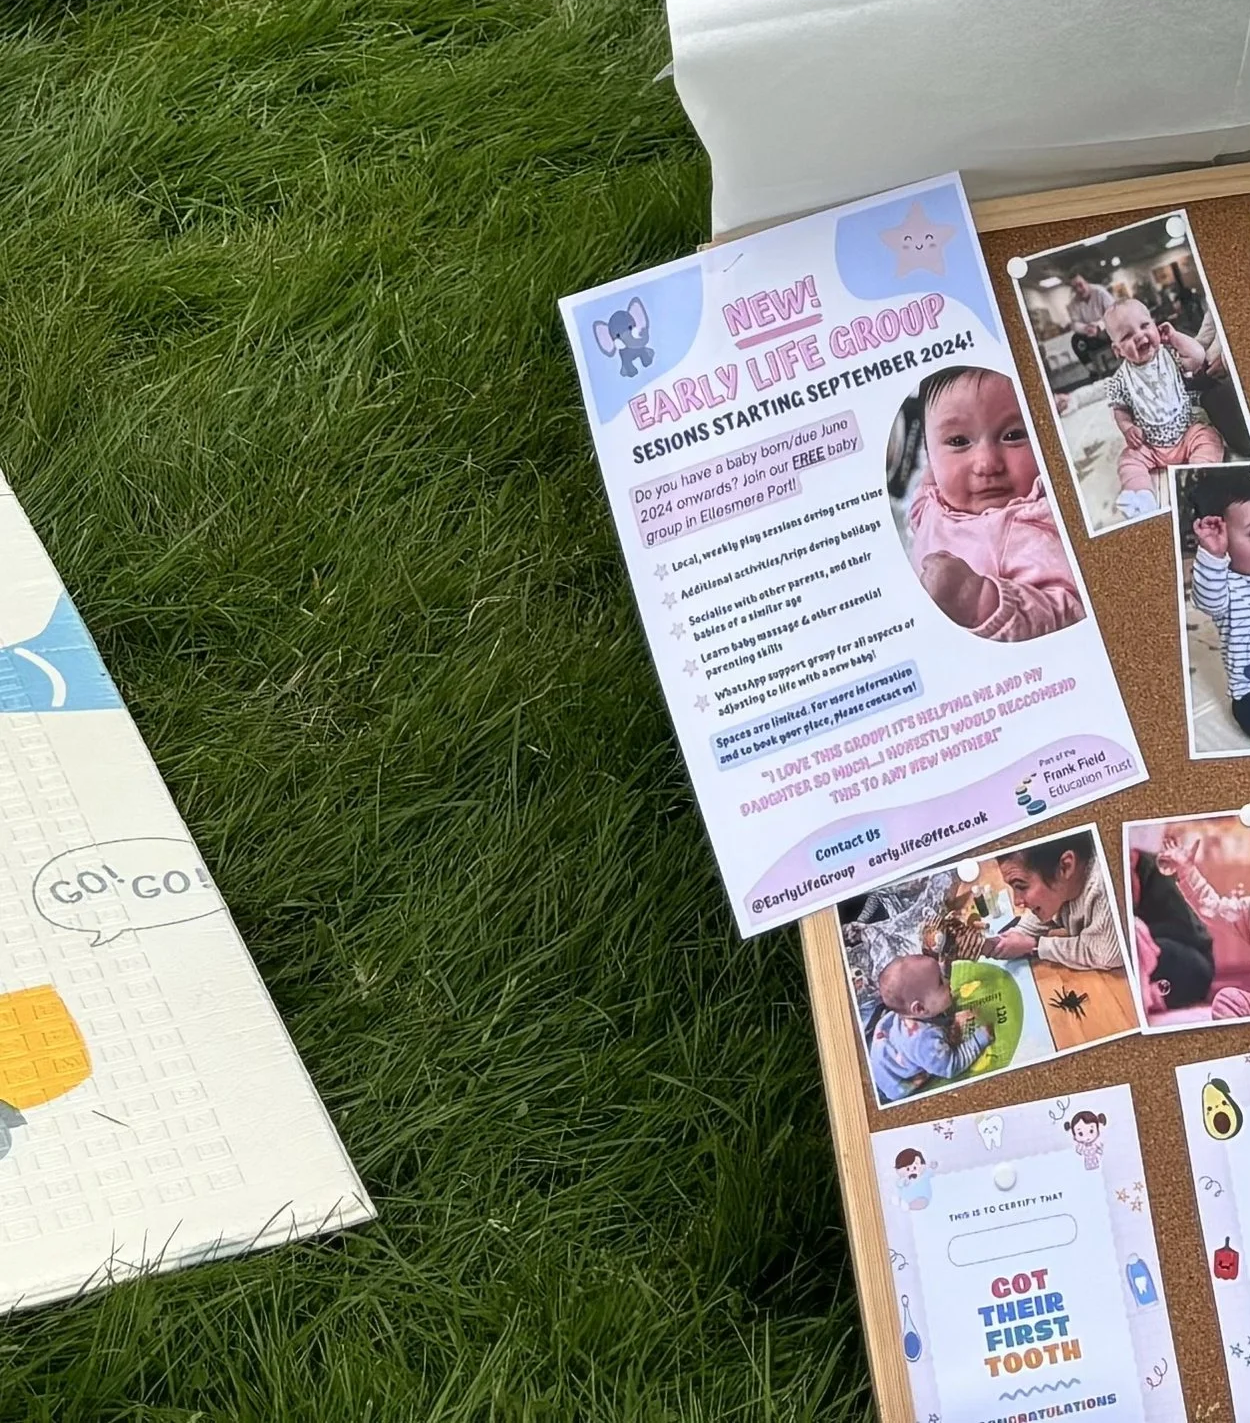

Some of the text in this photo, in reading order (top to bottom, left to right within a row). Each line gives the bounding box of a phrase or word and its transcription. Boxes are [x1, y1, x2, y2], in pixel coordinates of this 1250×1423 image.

[721, 274, 822, 337] NEW!
[629, 292, 946, 431] EARLY LIFE GROUP
[632, 330, 975, 465] SESIONS STARTING SEPTEMBER 2024!
[634, 419, 848, 504] Do you have a baby born/due June
[640, 436, 858, 524] 2024 onwards? Join our FREE baby
[646, 522, 683, 546] group
[685, 515, 697, 529] in
[699, 492, 765, 524] Ellesmere
[671, 488, 883, 573] Local, weekly play sessions during term time
[681, 520, 882, 600] Additional activities/trips during holidays
[1038, 756, 1055, 768] Part
[1043, 750, 1106, 784] Frank Field
[1048, 758, 1133, 799] Education Trust
[751, 811, 989, 914] @EarlyLifeGroup early.life@ffet.co.uk
[815, 828, 881, 862] Contact Us
[50, 864, 213, 905] GO! GO!
[948, 1211, 970, 1222] THIS
[983, 1205, 997, 1214] TO
[998, 1197, 1037, 1212] CERTIFY
[1039, 1191, 1063, 1203] THAT
[977, 1291, 1065, 1328] THEIR
[985, 1314, 1070, 1353] FIRST
[983, 1338, 1082, 1378] TOOTH
